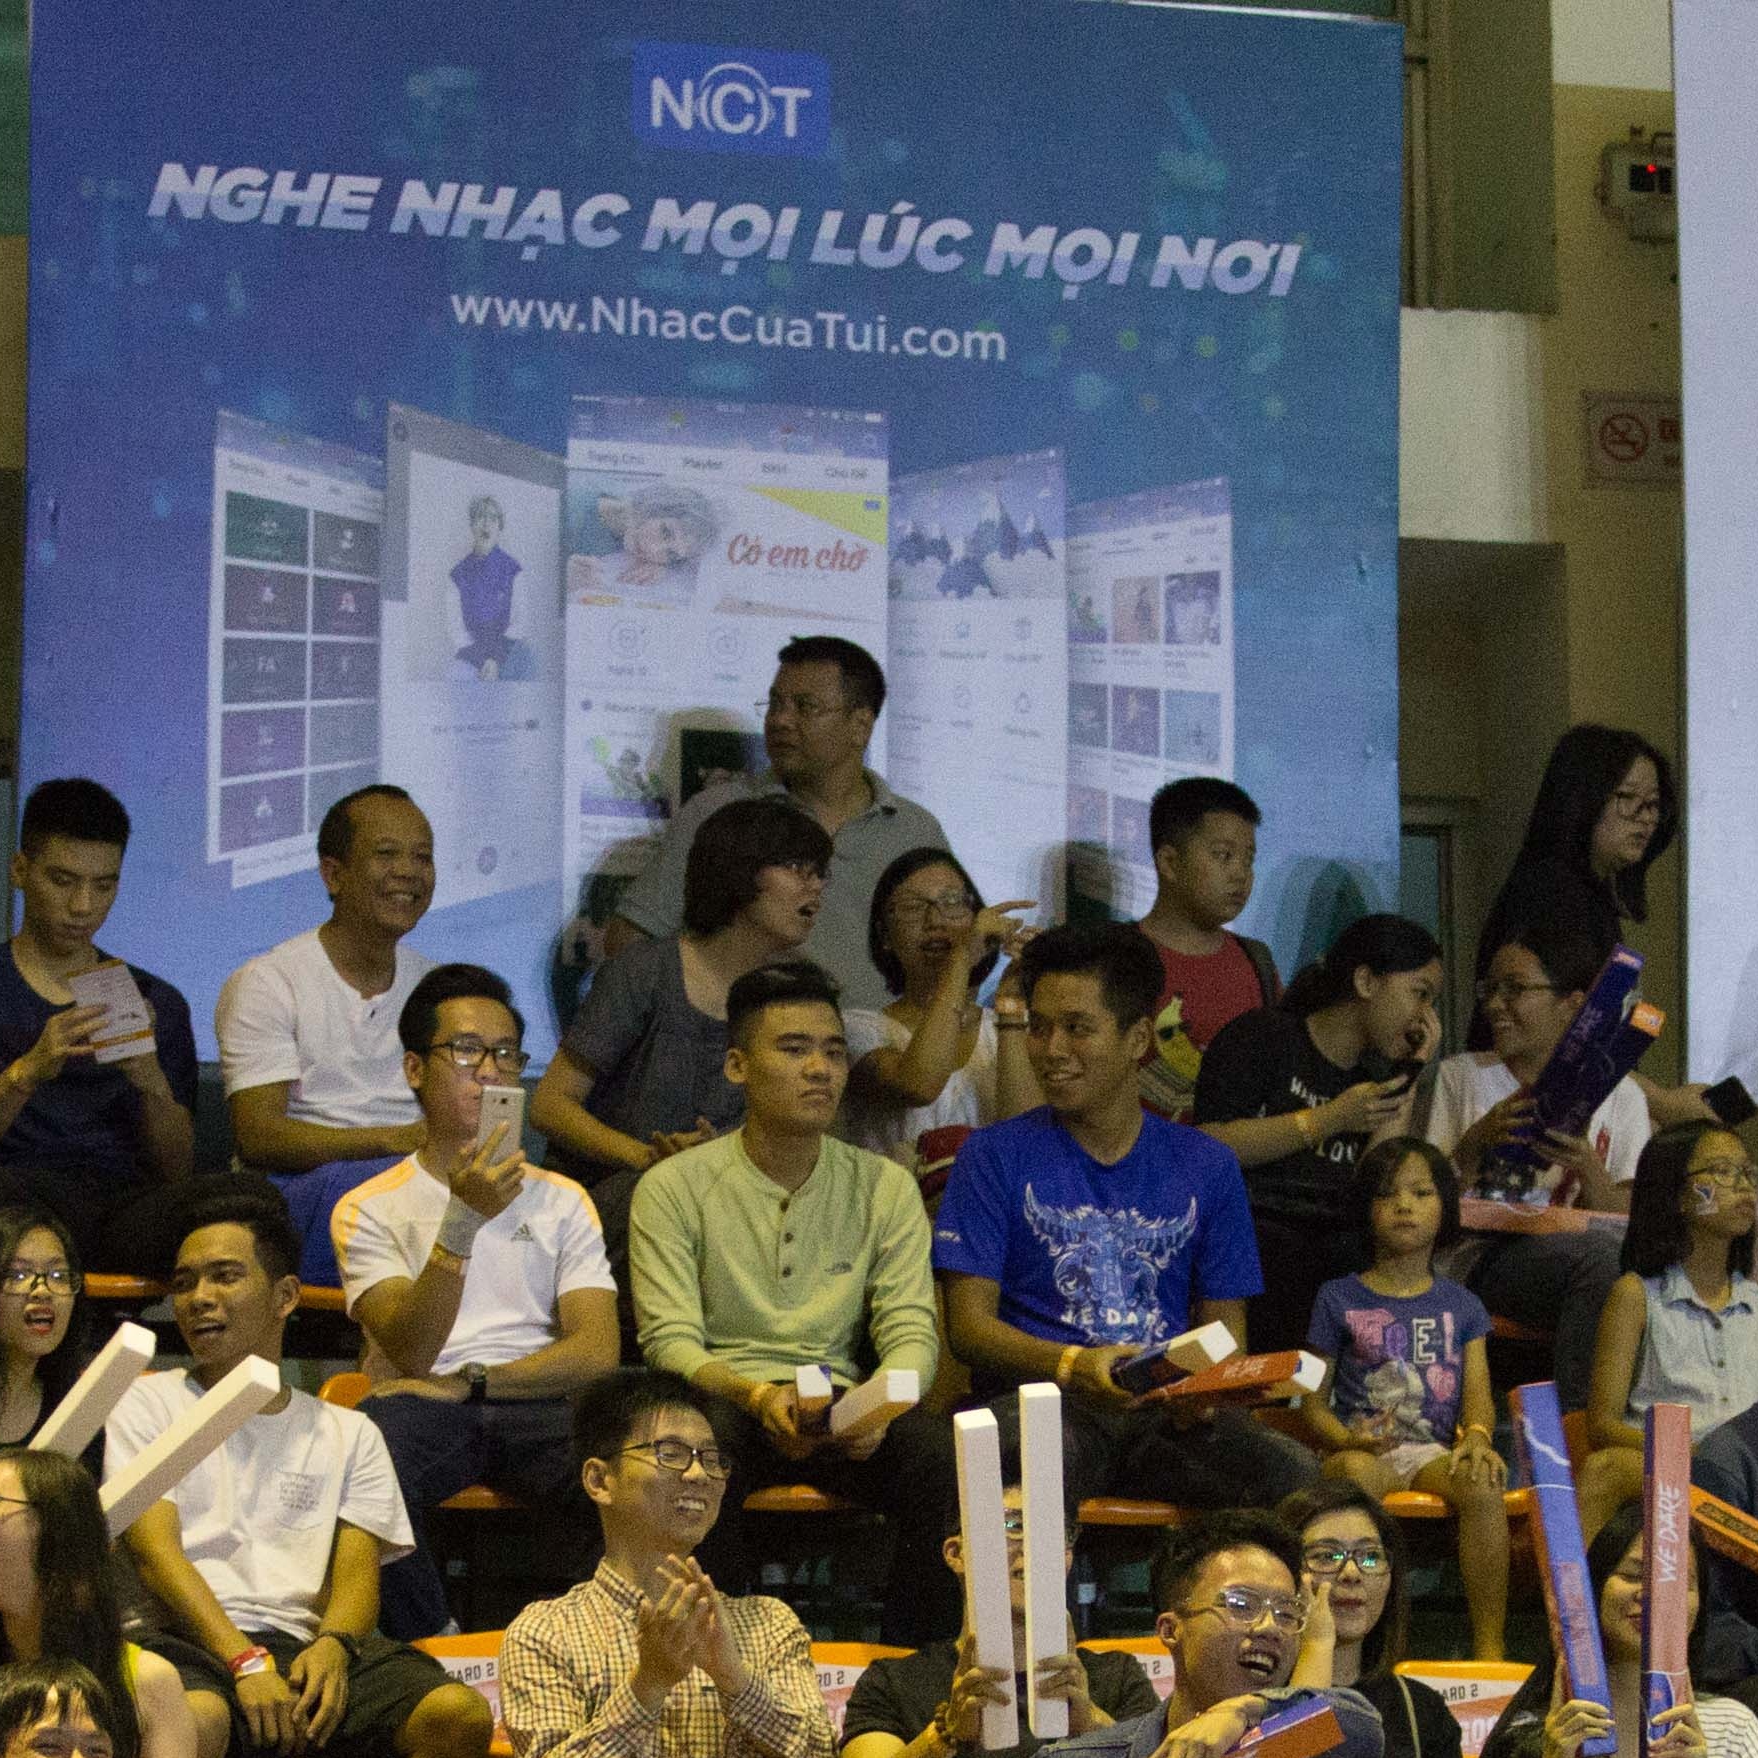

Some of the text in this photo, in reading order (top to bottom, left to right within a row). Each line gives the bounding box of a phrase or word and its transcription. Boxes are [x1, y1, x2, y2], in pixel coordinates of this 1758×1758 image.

[651, 70, 812, 139] NCT
[148, 162, 1302, 299] NGHE NHẠC MỌI LÚC MỌI NƠI
[451, 291, 1008, 363] www.NhacCuaTui.com
